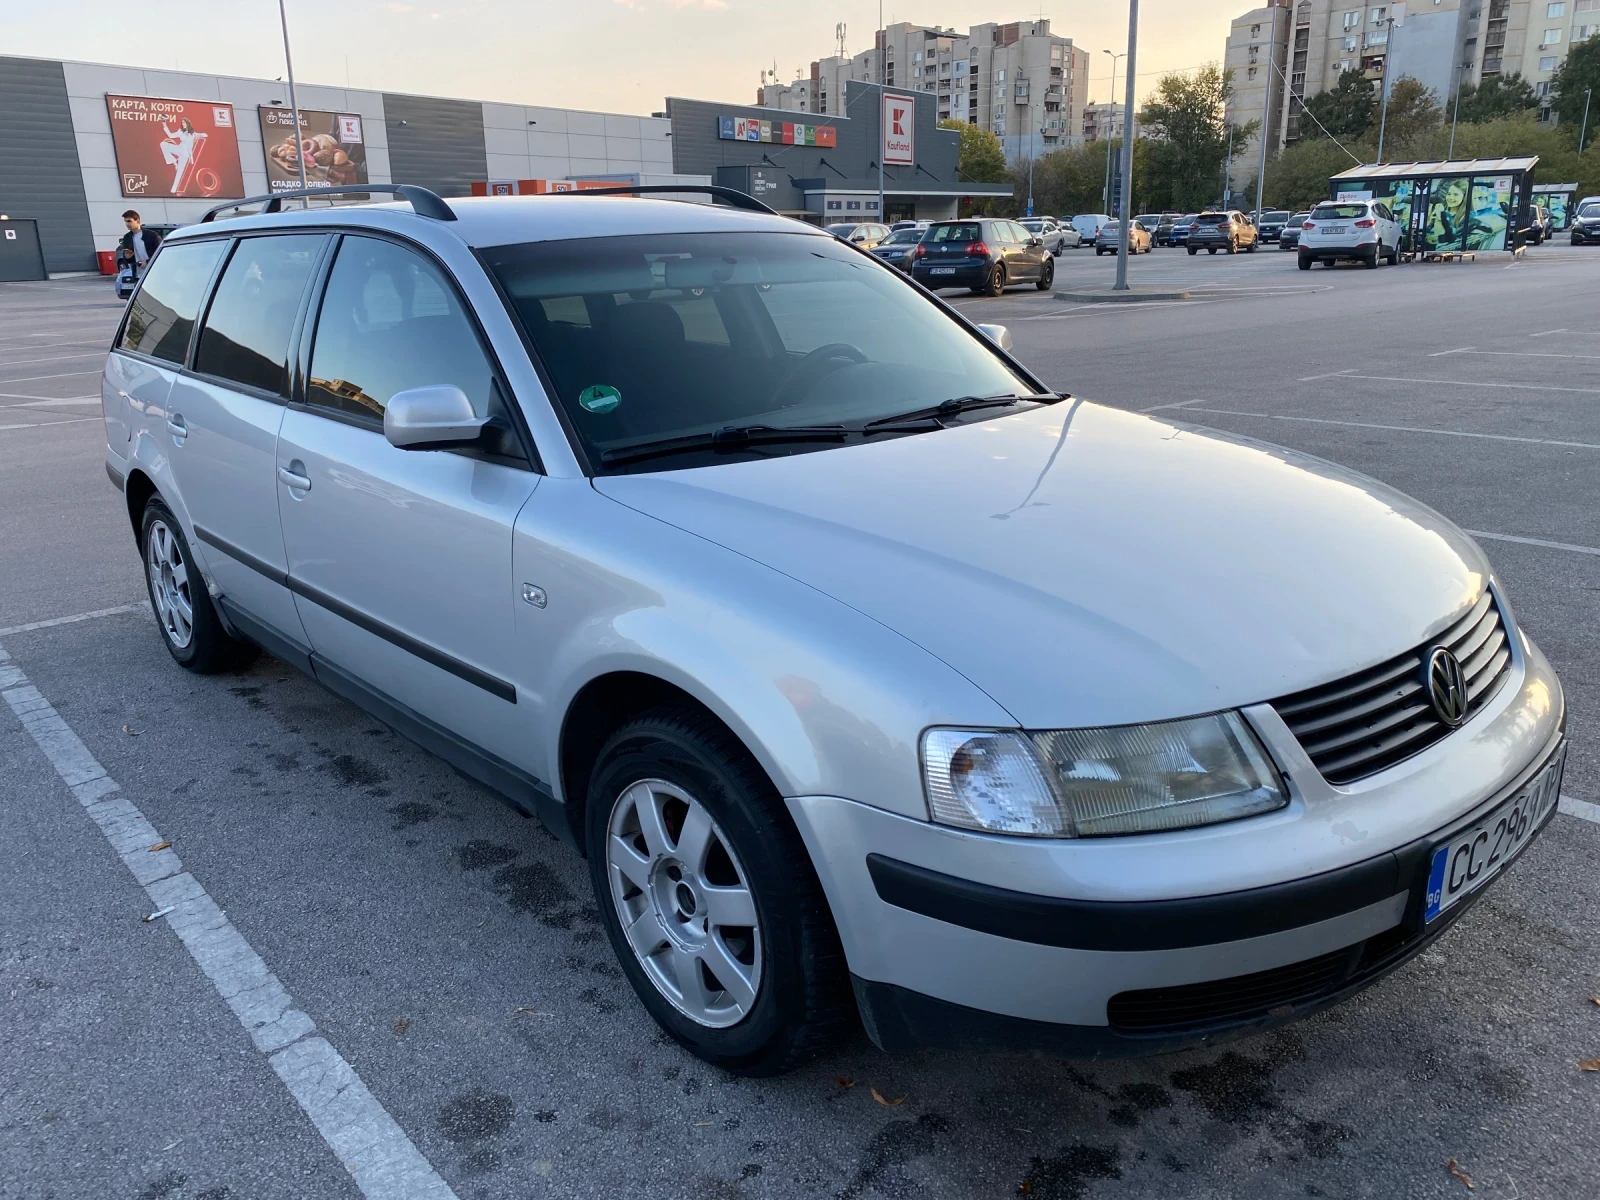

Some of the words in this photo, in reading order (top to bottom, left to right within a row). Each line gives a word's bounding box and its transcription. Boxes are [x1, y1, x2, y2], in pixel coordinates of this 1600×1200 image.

[112, 99, 149, 112] КАРТА,
[150, 102, 184, 113] КОЯТО
[114, 110, 147, 121] ПЕСТИ
[149, 113, 177, 123] ПАРИ
[887, 140, 910, 151] Kaufland
[128, 175, 149, 191] Card
[271, 180, 302, 188] СЛАДКО
[1448, 830, 1488, 894] CC
[1427, 889, 1441, 908] BG
